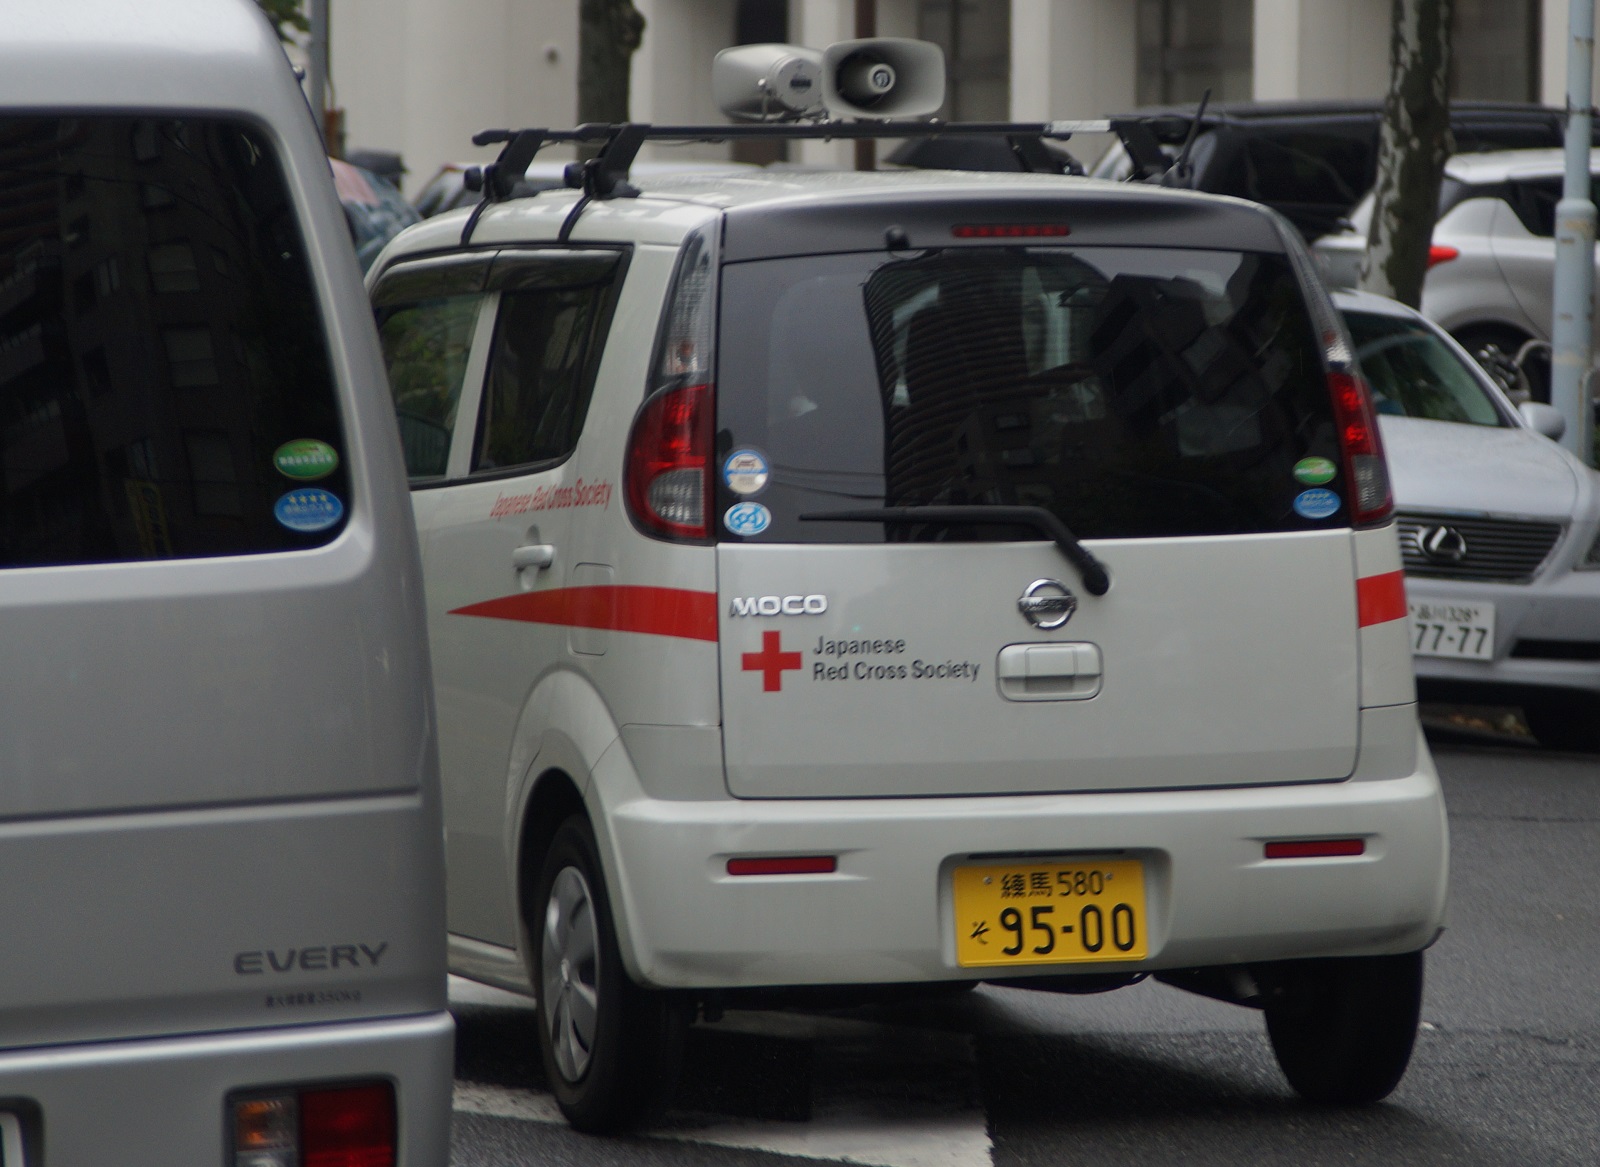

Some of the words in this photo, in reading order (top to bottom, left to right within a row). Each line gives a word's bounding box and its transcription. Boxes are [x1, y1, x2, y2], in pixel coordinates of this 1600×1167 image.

[573, 476, 614, 512] Society
[729, 594, 828, 618] MOCO
[813, 635, 906, 659] Japanese
[1414, 622, 1488, 655] 77-77
[812, 661, 849, 681] Red
[853, 660, 908, 681] Cross
[910, 658, 981, 683] Society
[999, 902, 1137, 956] 95-00
[232, 941, 389, 975] EVERY
